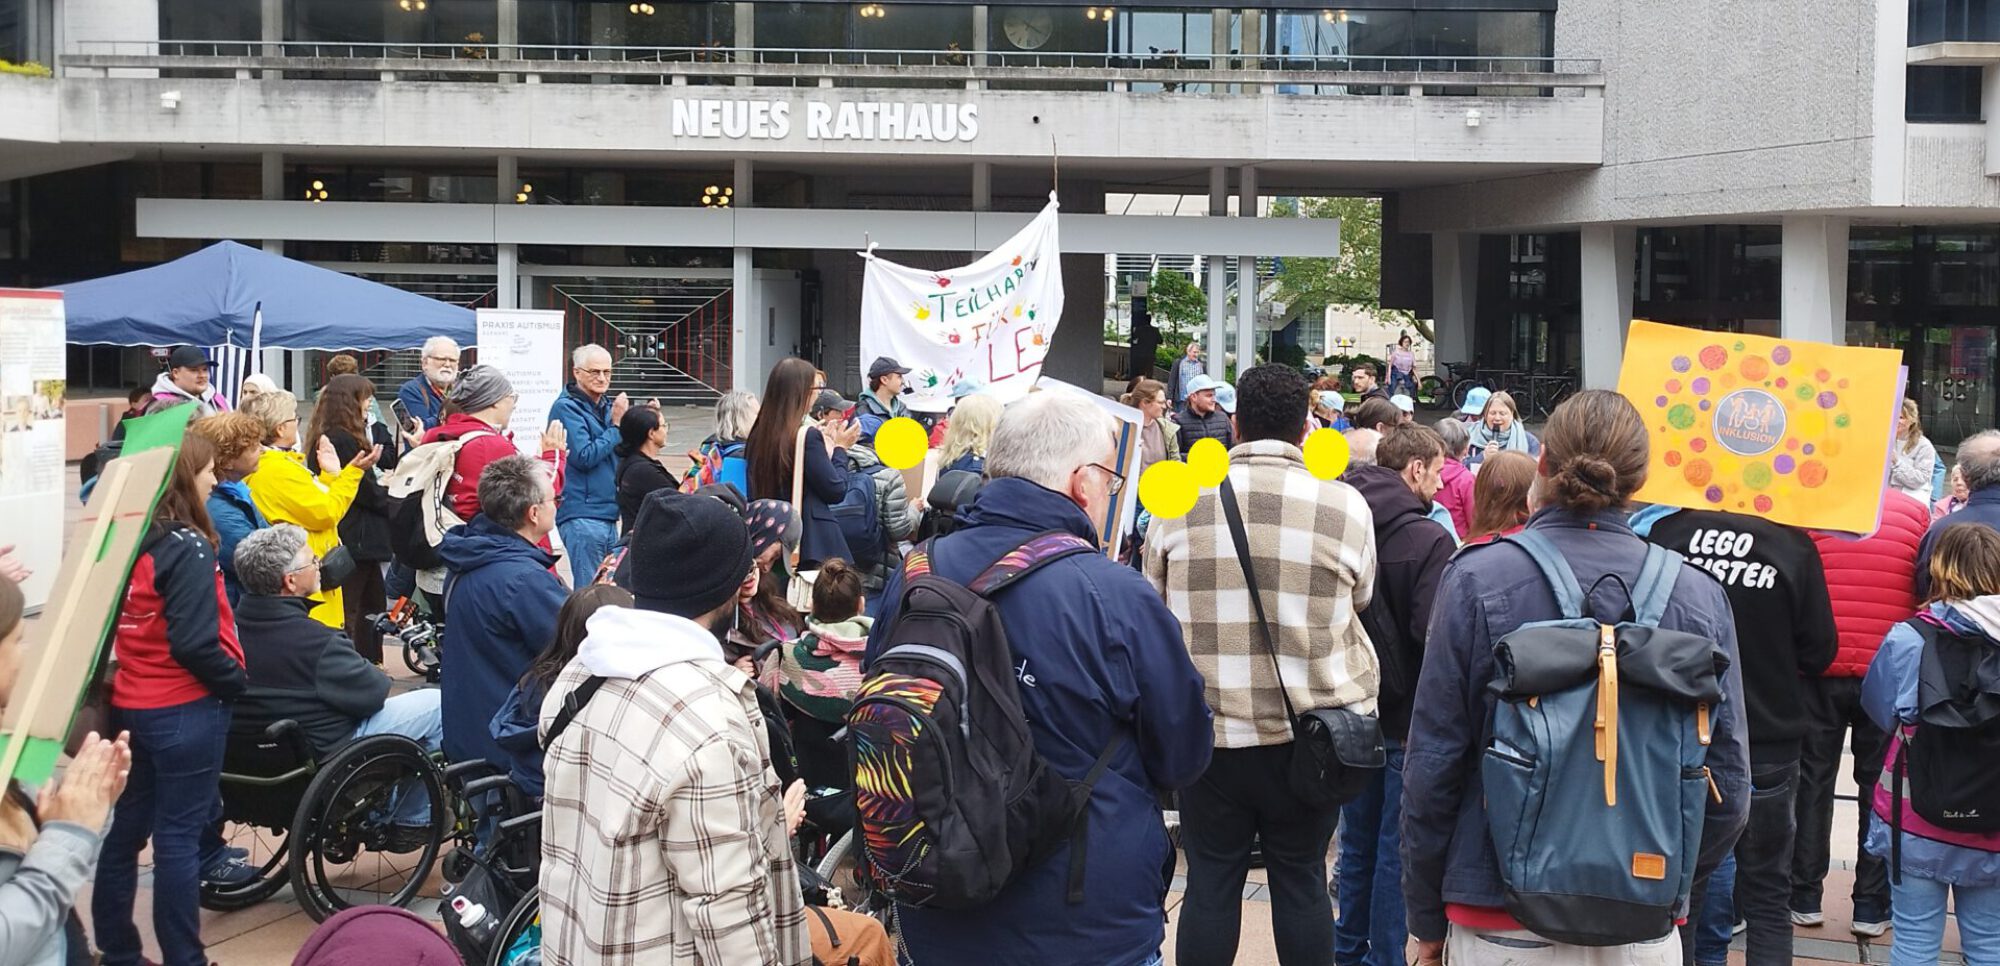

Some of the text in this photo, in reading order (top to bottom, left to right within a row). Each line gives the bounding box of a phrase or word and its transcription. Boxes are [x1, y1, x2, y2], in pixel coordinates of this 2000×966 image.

[672, 99, 979, 142] NEUES RATHAUS
[482, 321, 561, 330] PRAXIS AUTISMUS
[1718, 426, 1777, 444] INKLUSION
[1689, 528, 1754, 558] LEGO
[1683, 556, 1778, 589] ISTER
